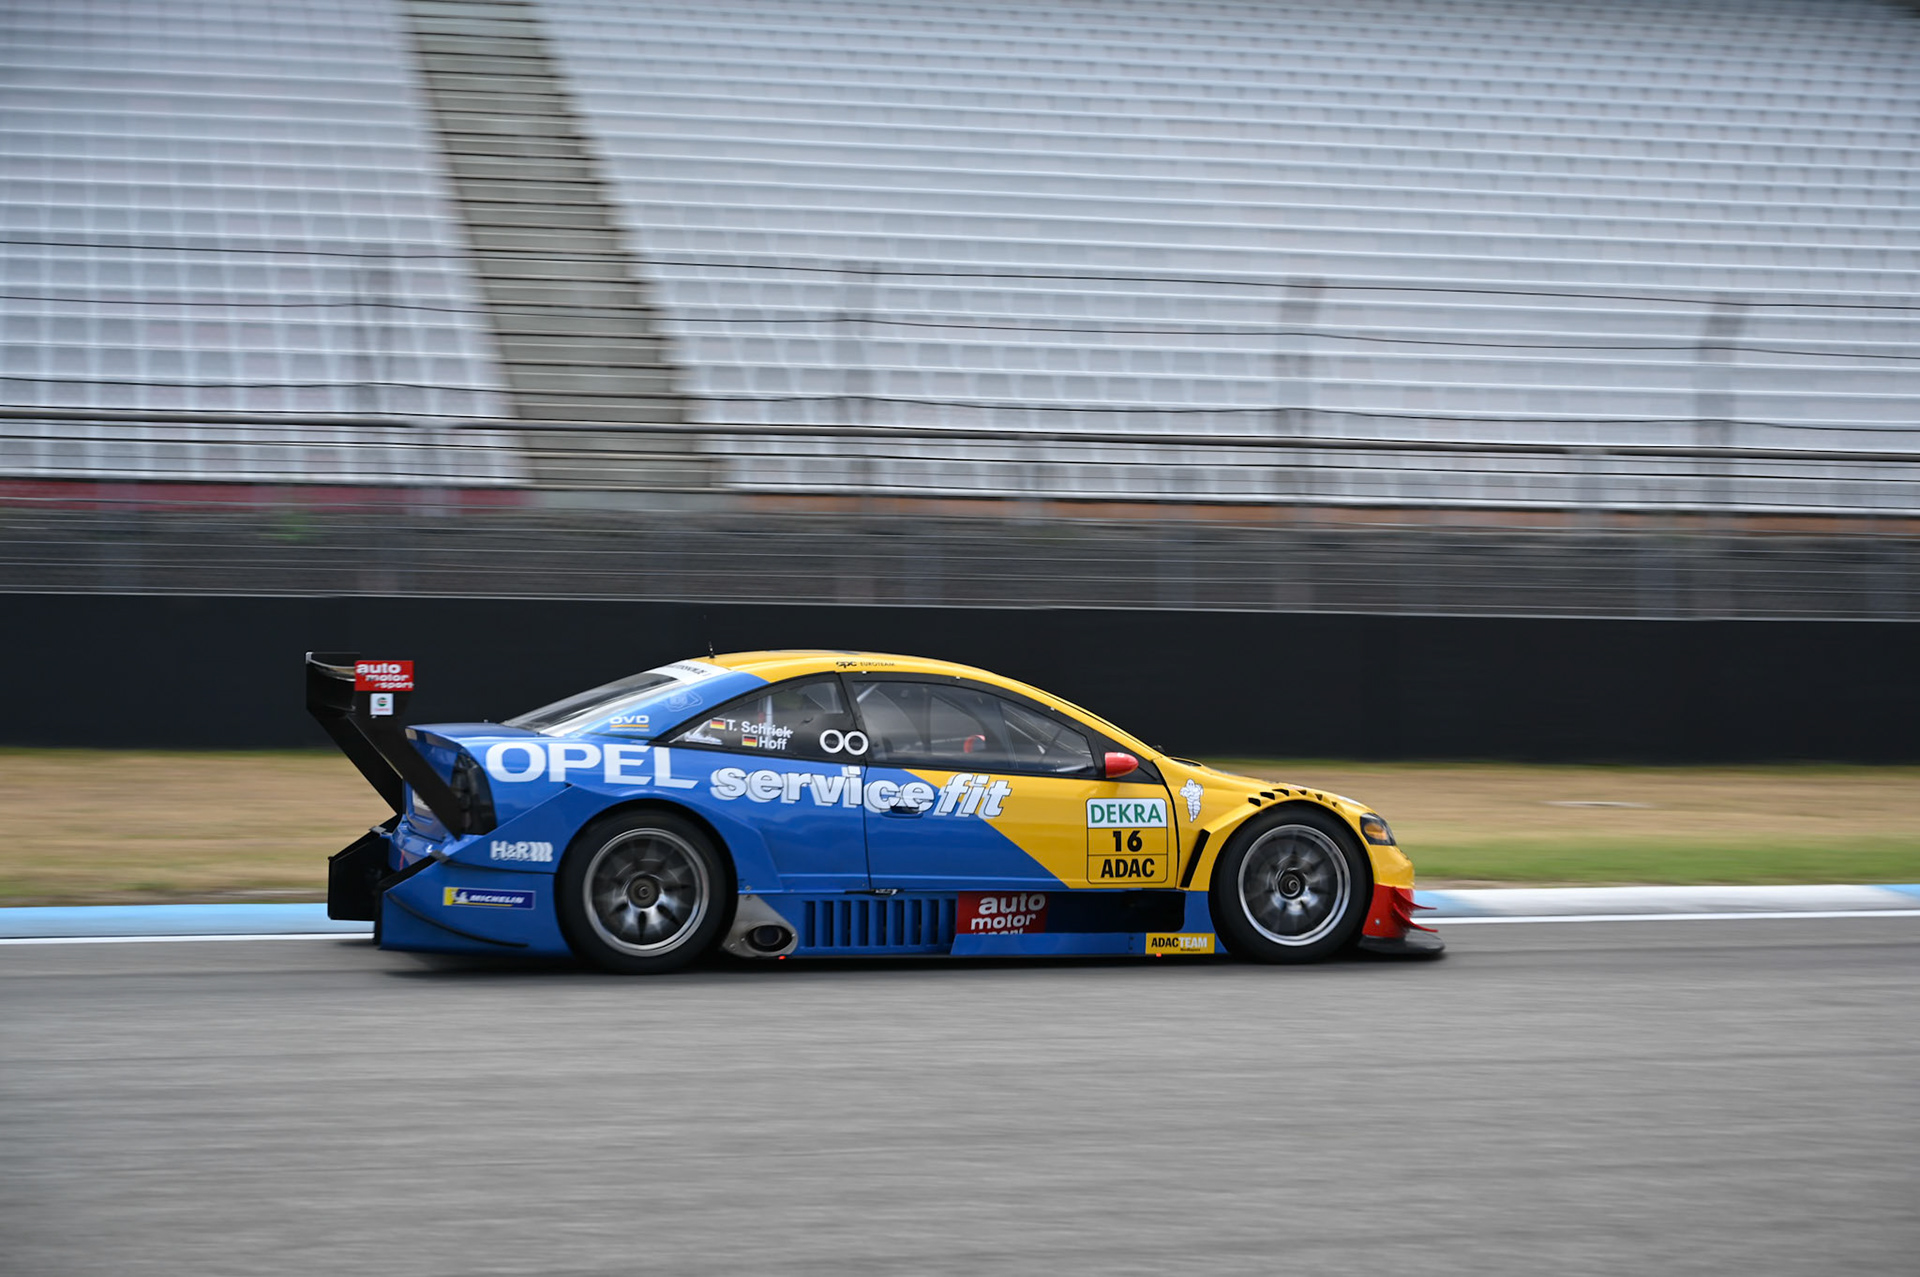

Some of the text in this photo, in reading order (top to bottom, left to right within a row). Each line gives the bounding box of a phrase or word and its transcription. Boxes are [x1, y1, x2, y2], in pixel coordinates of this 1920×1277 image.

[356, 663, 402, 674] auto
[609, 715, 649, 724] OVD
[726, 719, 737, 731] T.
[759, 735, 788, 750] Hoff
[485, 742, 699, 789] OPEL
[710, 765, 1012, 819] service fit
[1090, 803, 1163, 823] DEKRA
[490, 840, 550, 862] H&R
[1112, 830, 1143, 852] 16
[1100, 858, 1155, 878] ADAC
[469, 894, 525, 904] MICHELIN
[978, 893, 1046, 915] auto
[970, 913, 1036, 930] motor
